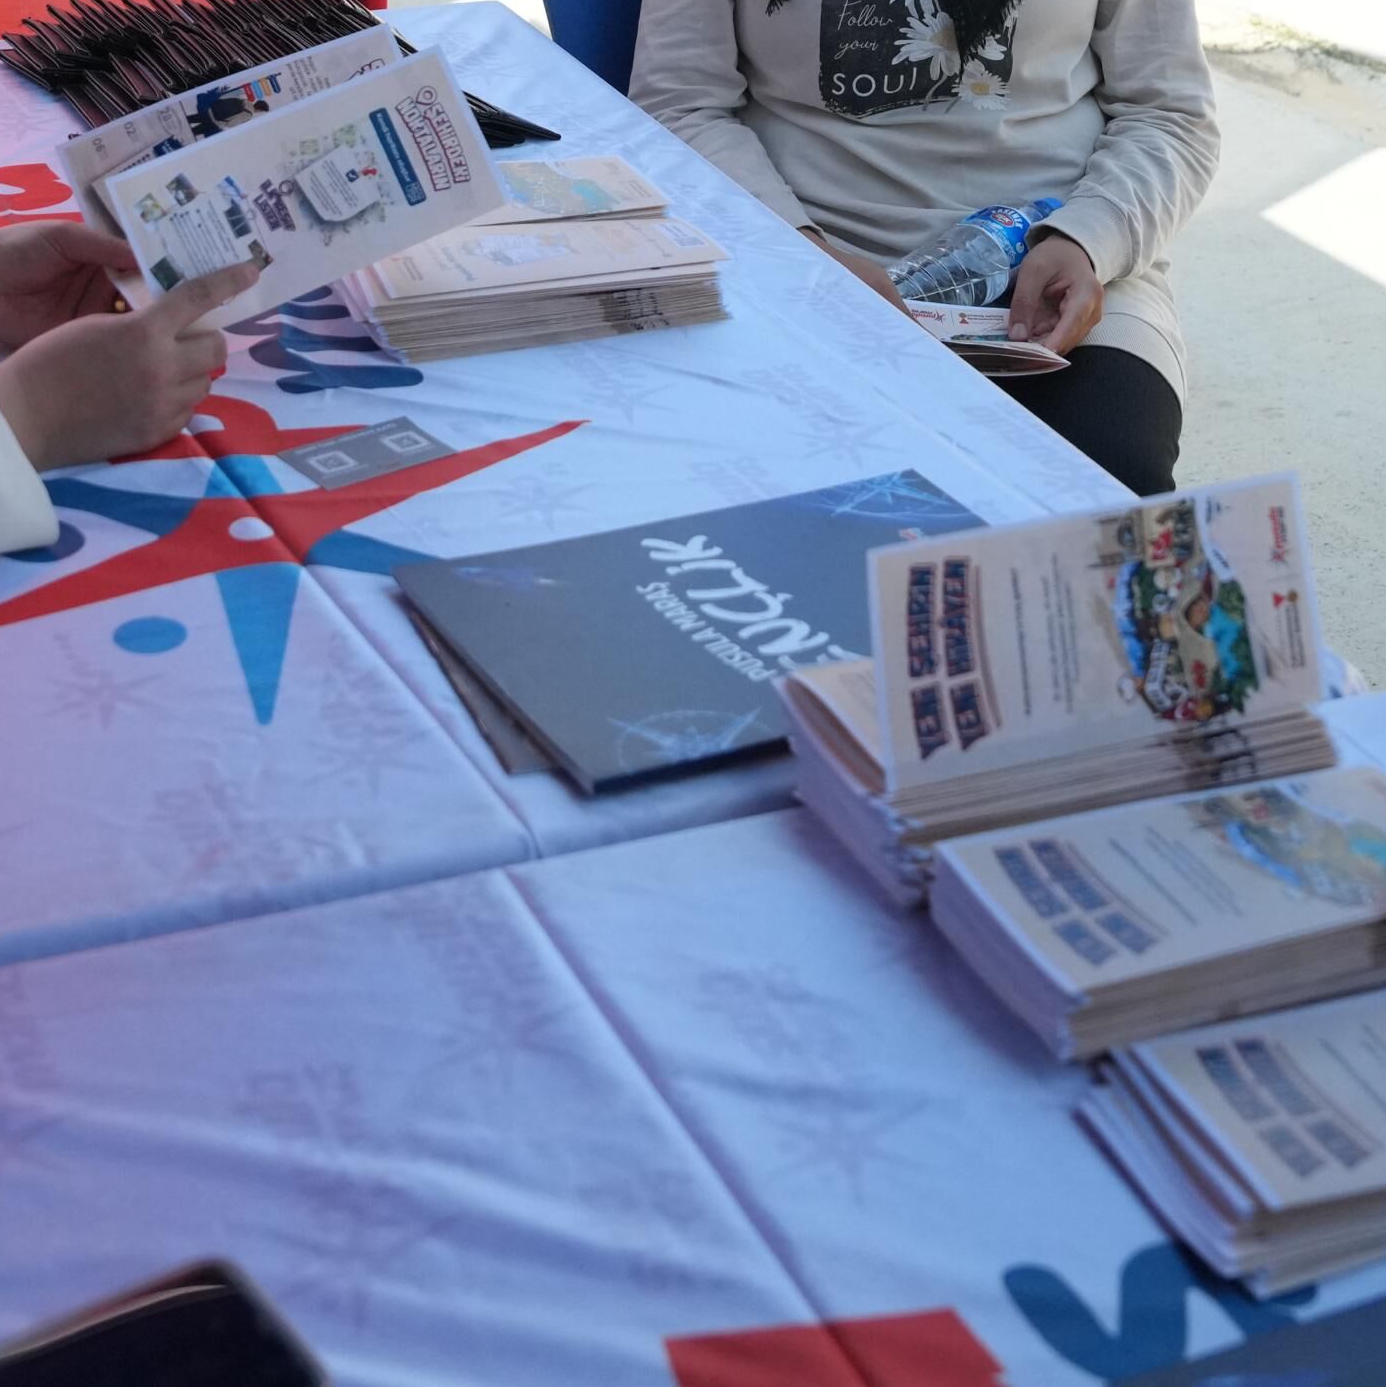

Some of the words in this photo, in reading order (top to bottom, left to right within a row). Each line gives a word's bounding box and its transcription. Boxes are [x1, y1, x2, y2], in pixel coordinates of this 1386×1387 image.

[837, 0, 894, 31] Follow
[834, 39, 879, 61] your
[395, 96, 452, 192] NOKTALARIN
[691, 626, 778, 683] PUSULA
